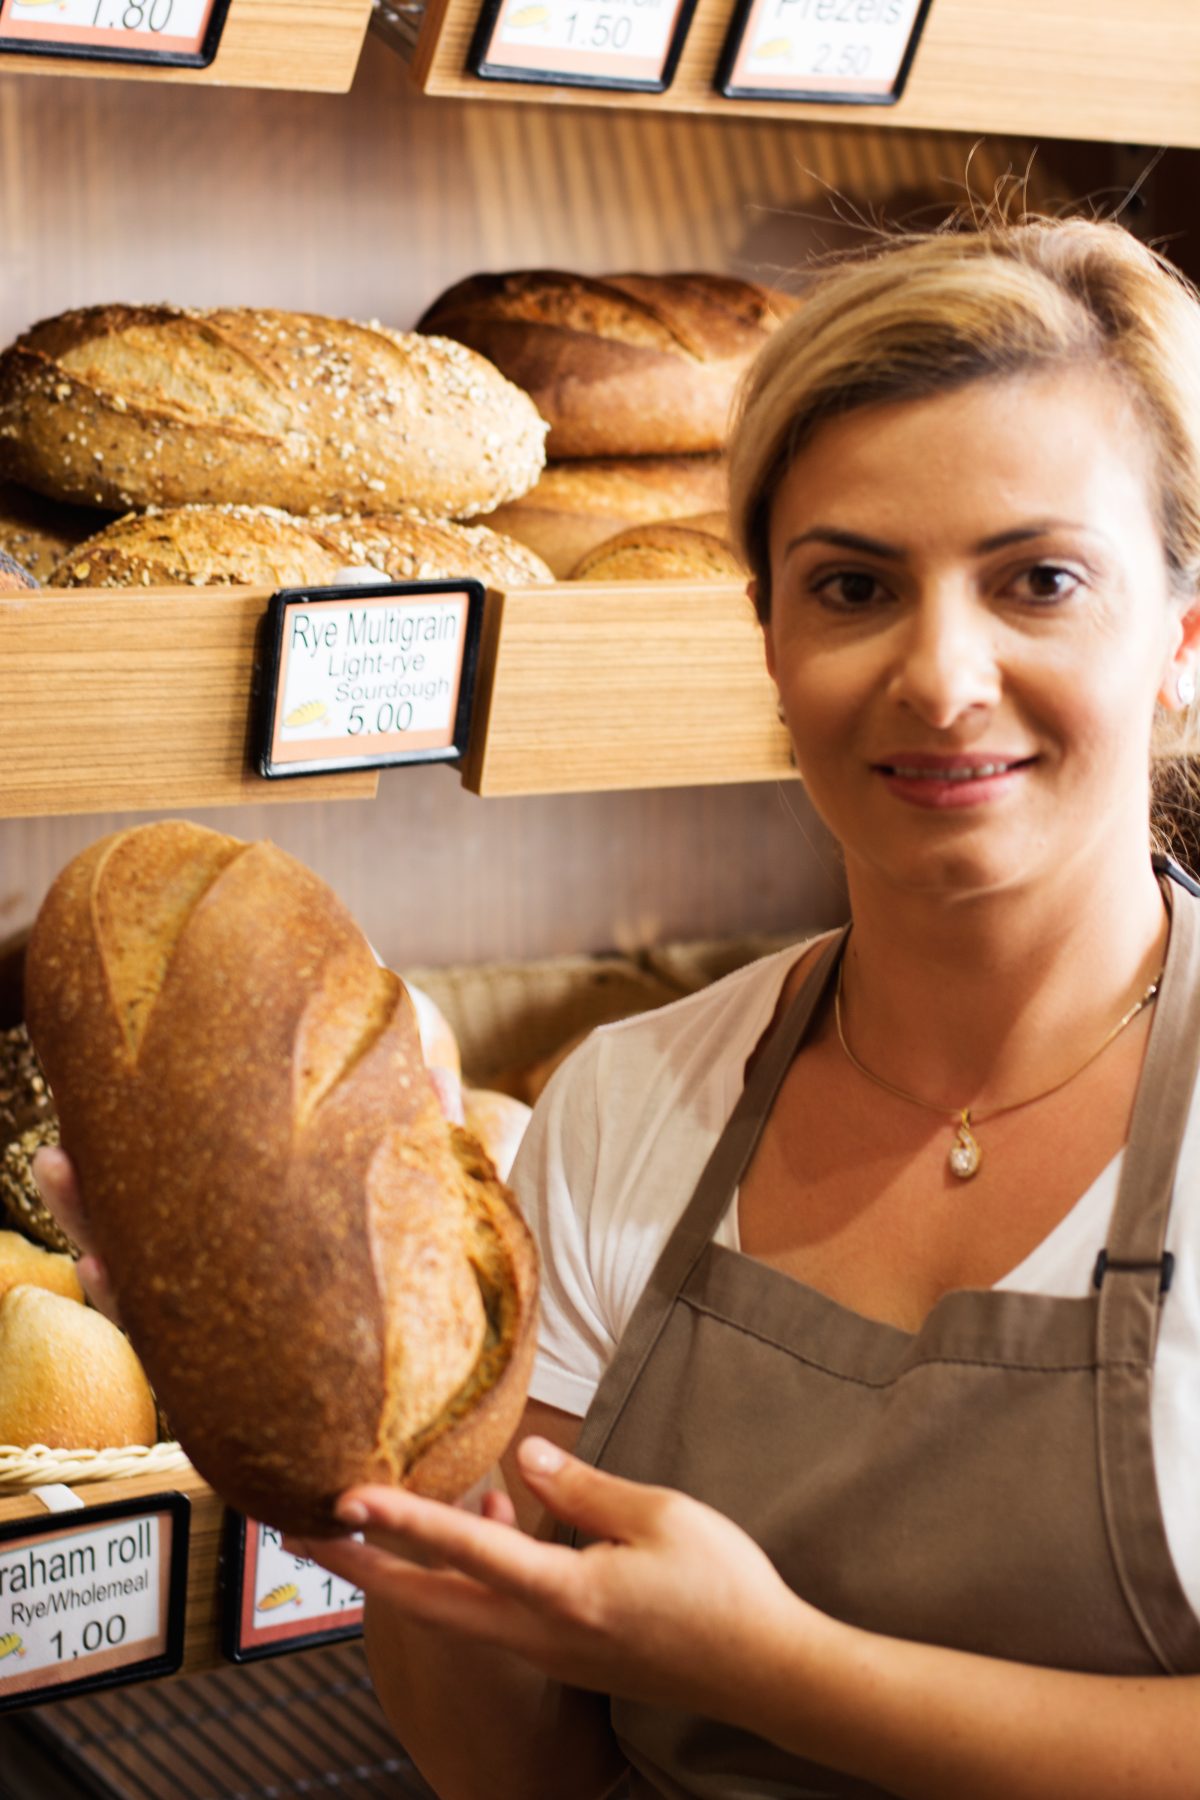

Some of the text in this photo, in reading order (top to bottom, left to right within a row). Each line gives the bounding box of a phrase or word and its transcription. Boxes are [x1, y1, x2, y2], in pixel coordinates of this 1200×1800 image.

[91, 0, 173, 32] 1.80
[565, 12, 633, 48] 1.50
[292, 606, 457, 658] Rye Multigrain
[328, 652, 426, 682] Light-rye
[335, 678, 450, 702] Sourdough
[347, 701, 414, 736] 5.00
[0, 1521, 151, 1596] raham roll
[11, 1568, 149, 1627] Rye/Wholemeal
[321, 1577, 364, 1609] 1,2
[50, 1614, 126, 1660] 1,00
